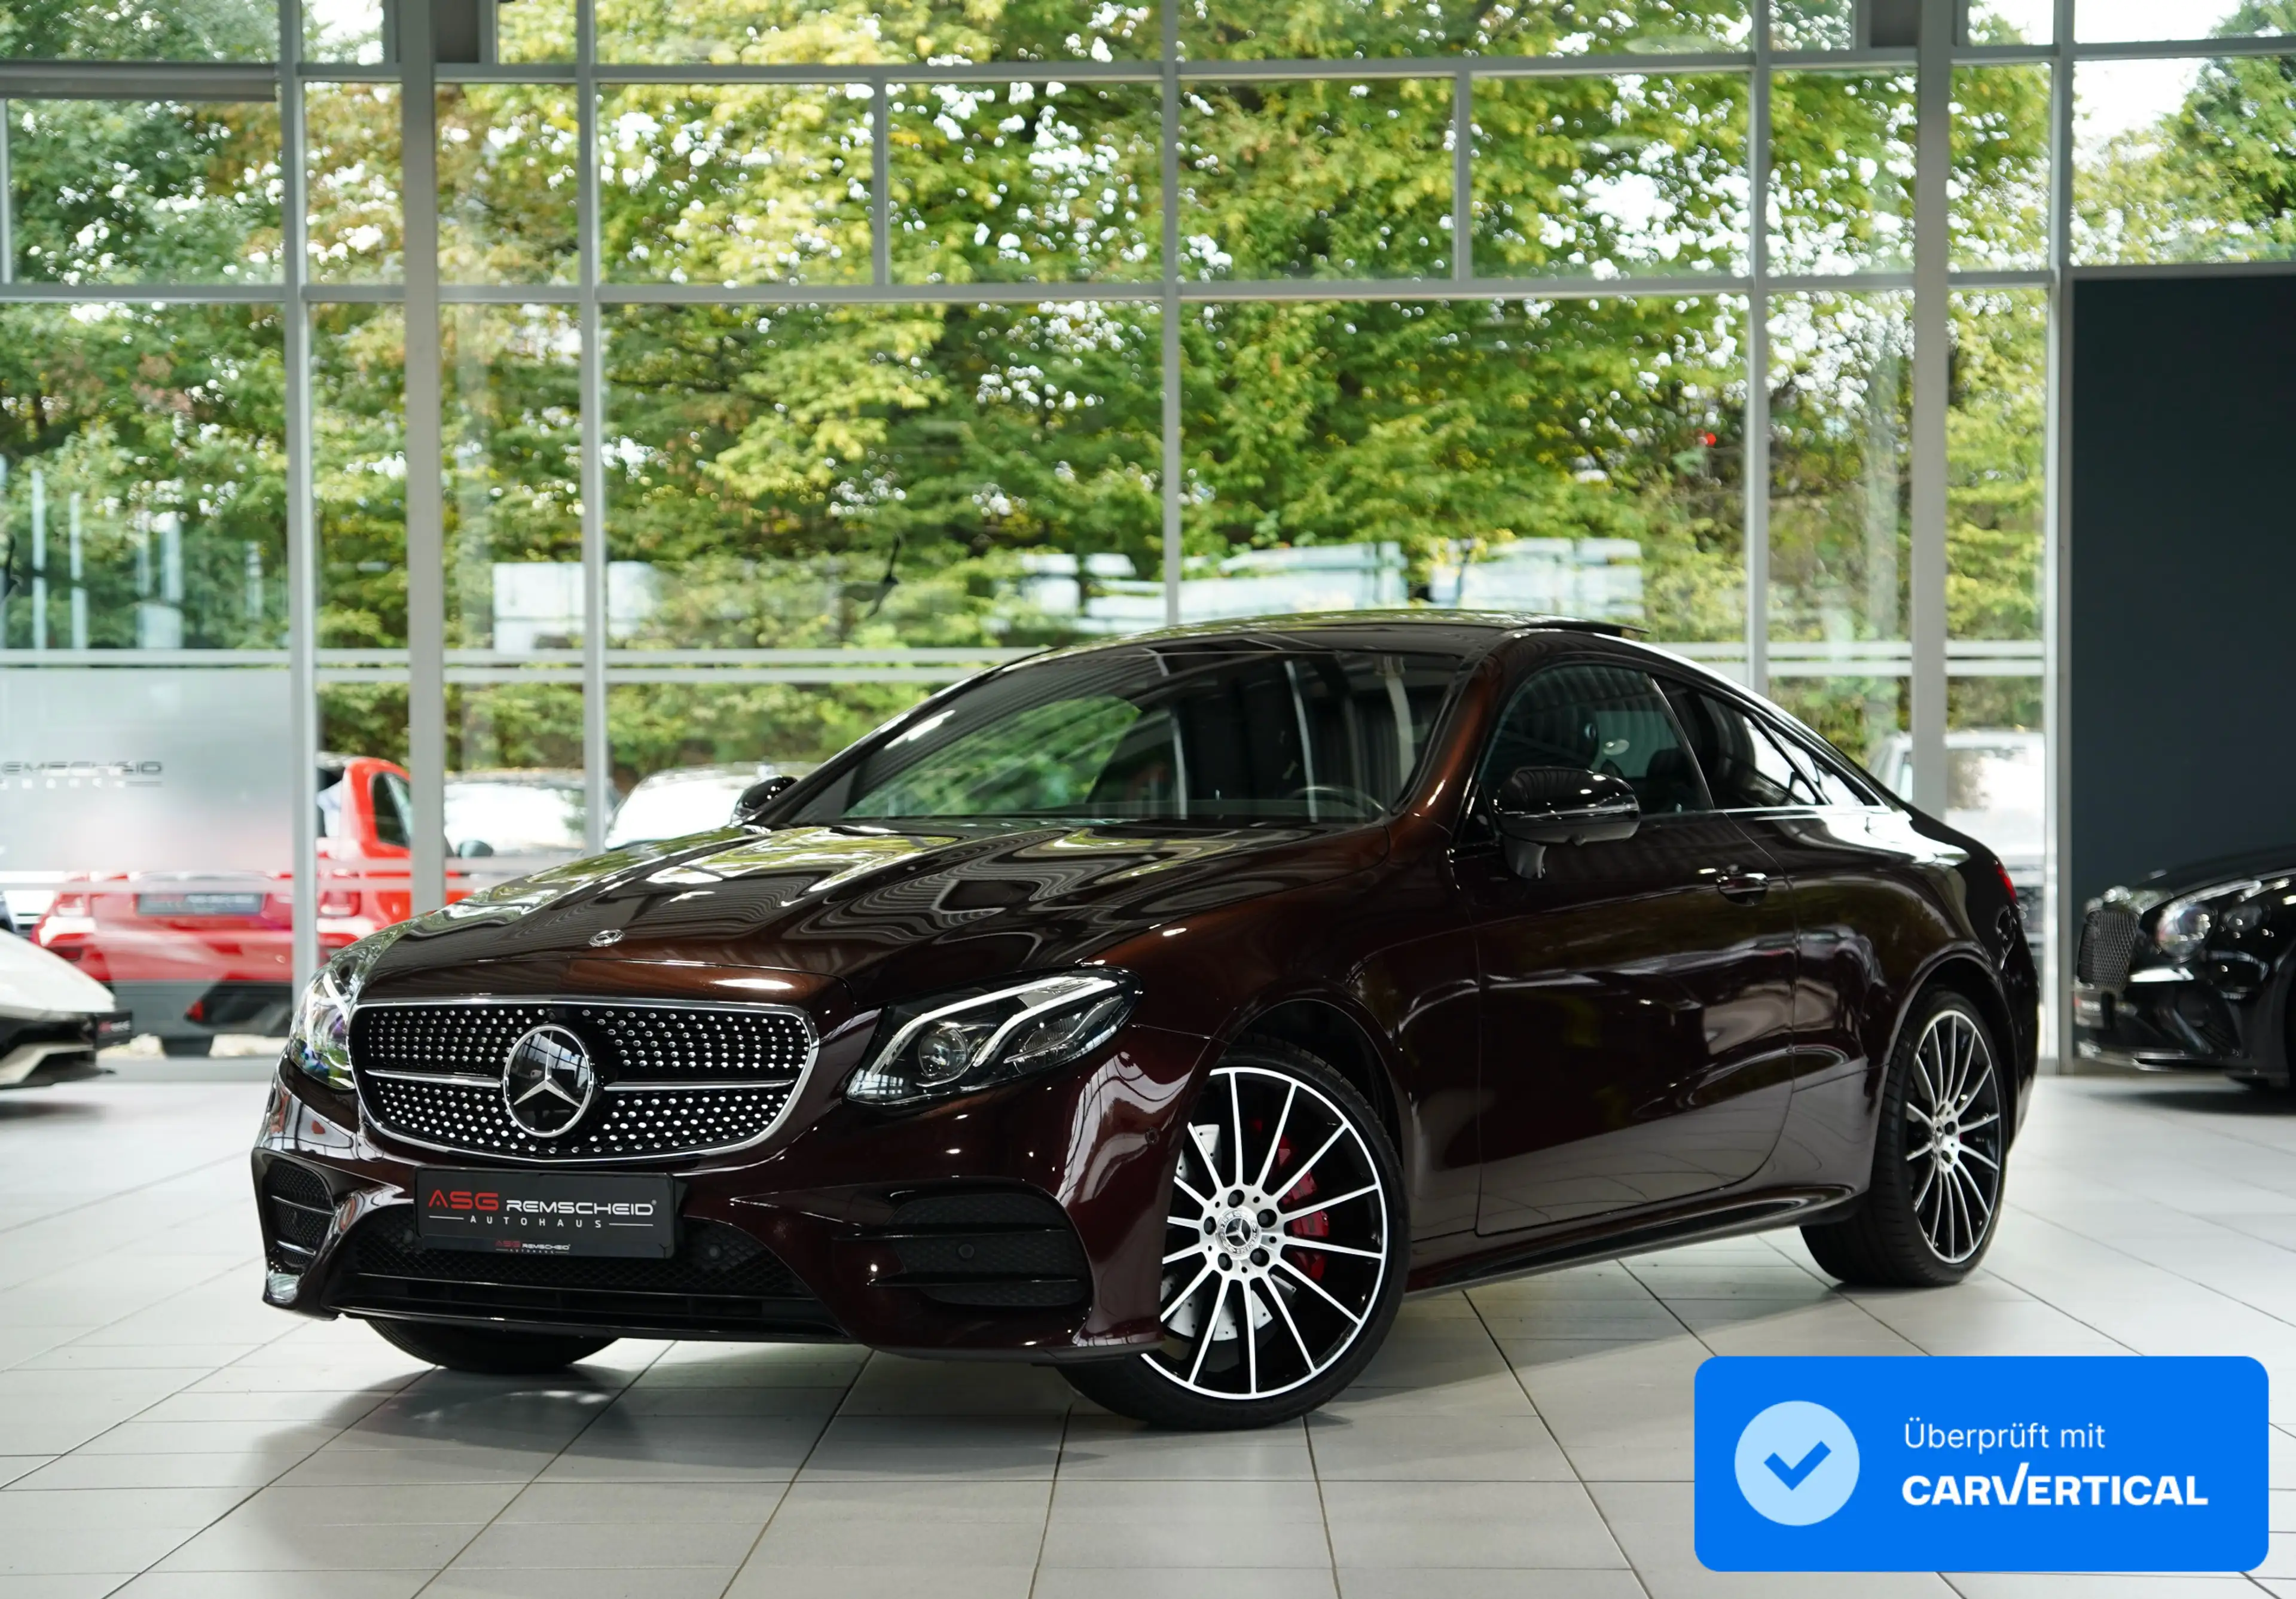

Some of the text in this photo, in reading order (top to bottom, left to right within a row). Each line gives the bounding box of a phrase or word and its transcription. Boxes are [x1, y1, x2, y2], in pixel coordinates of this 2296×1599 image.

[428, 1189, 654, 1216] ASG REMSCHEID
[470, 1215, 602, 1228] AUTOHAUS
